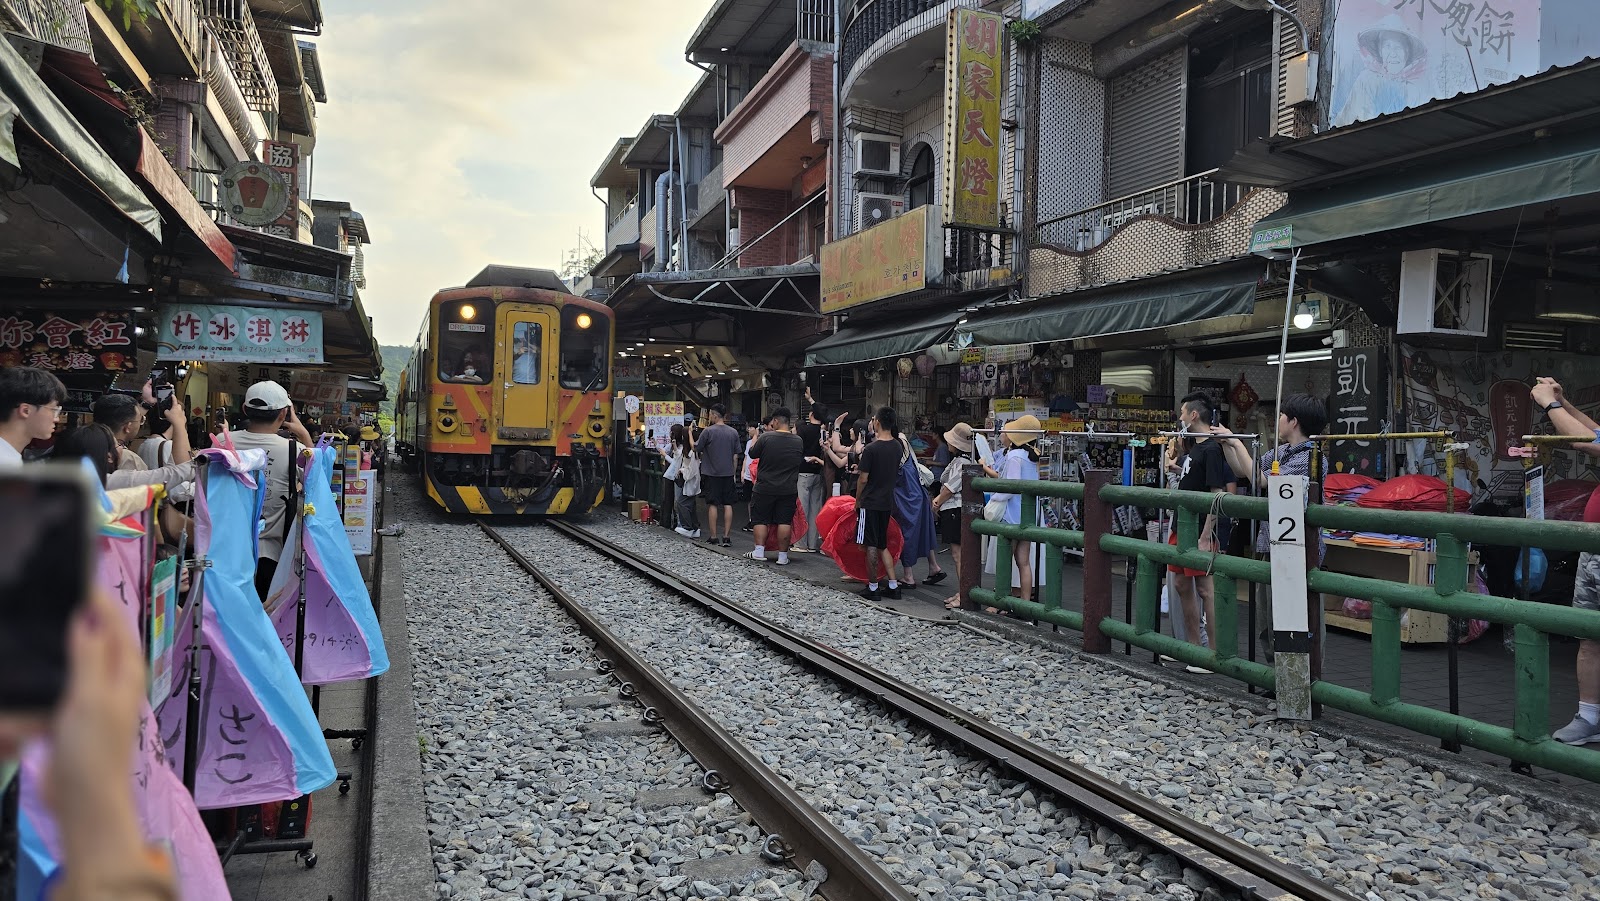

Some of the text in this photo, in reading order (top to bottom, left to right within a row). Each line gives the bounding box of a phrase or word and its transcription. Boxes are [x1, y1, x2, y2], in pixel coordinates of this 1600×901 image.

[961, 13, 998, 196] 胡家天燈
[170, 313, 310, 344] 炸冰淇淋
[30, 352, 95, 370] 天燈
[1336, 353, 1371, 447] 凱元
[1279, 483, 1294, 500] 6
[1277, 516, 1297, 542] 2
